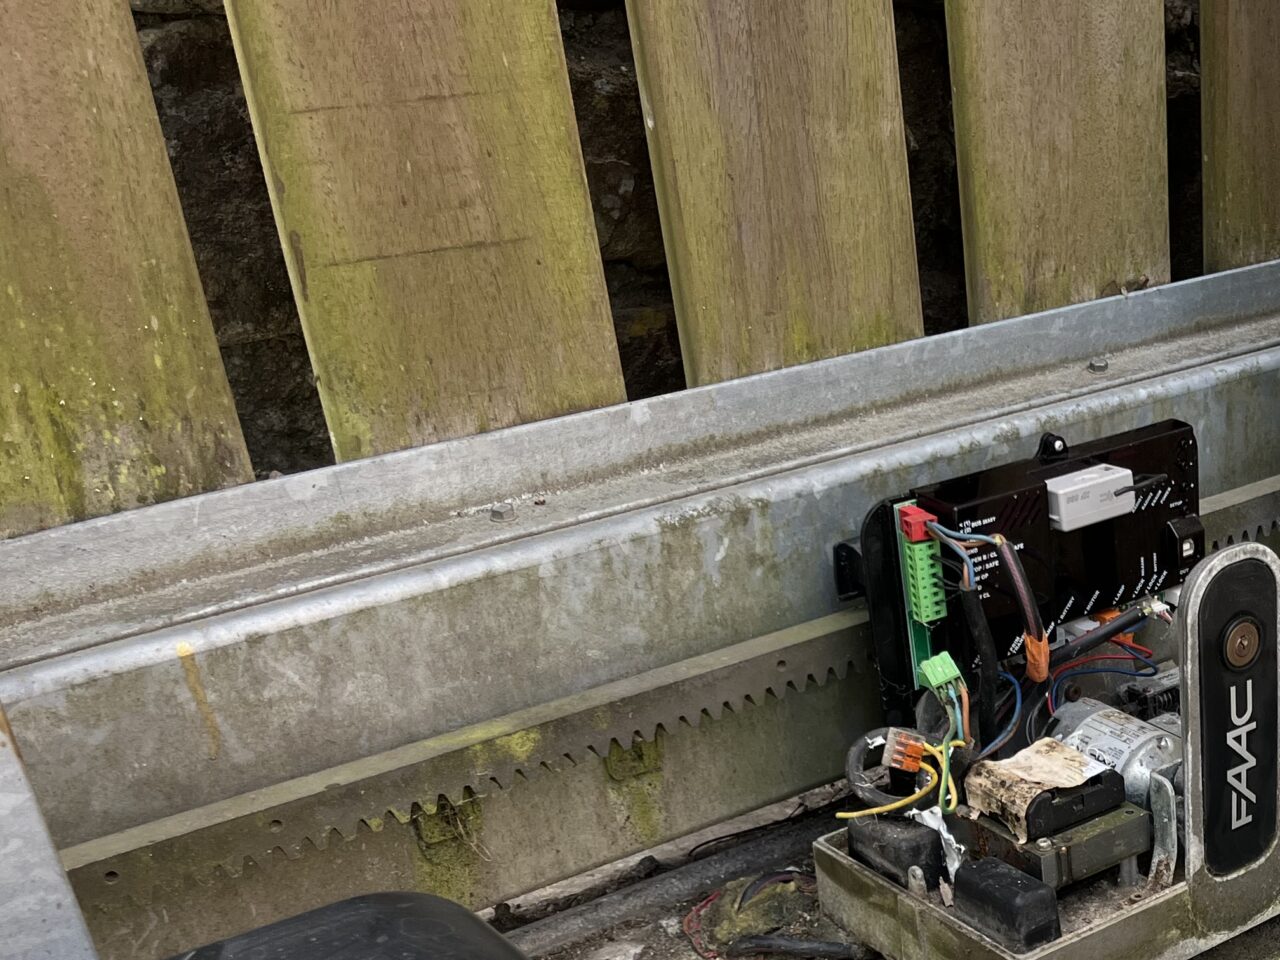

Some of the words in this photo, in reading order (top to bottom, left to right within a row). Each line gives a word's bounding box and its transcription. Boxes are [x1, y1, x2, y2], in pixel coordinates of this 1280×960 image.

[1134, 578, 1145, 594] LOCK
[1157, 570, 1168, 587] LOCK
[1086, 590, 1100, 611] MOTOR
[1115, 584, 1125, 601] LAMP
[1060, 596, 1075, 620] BATTERY
[1226, 679, 1257, 830] FAAC
